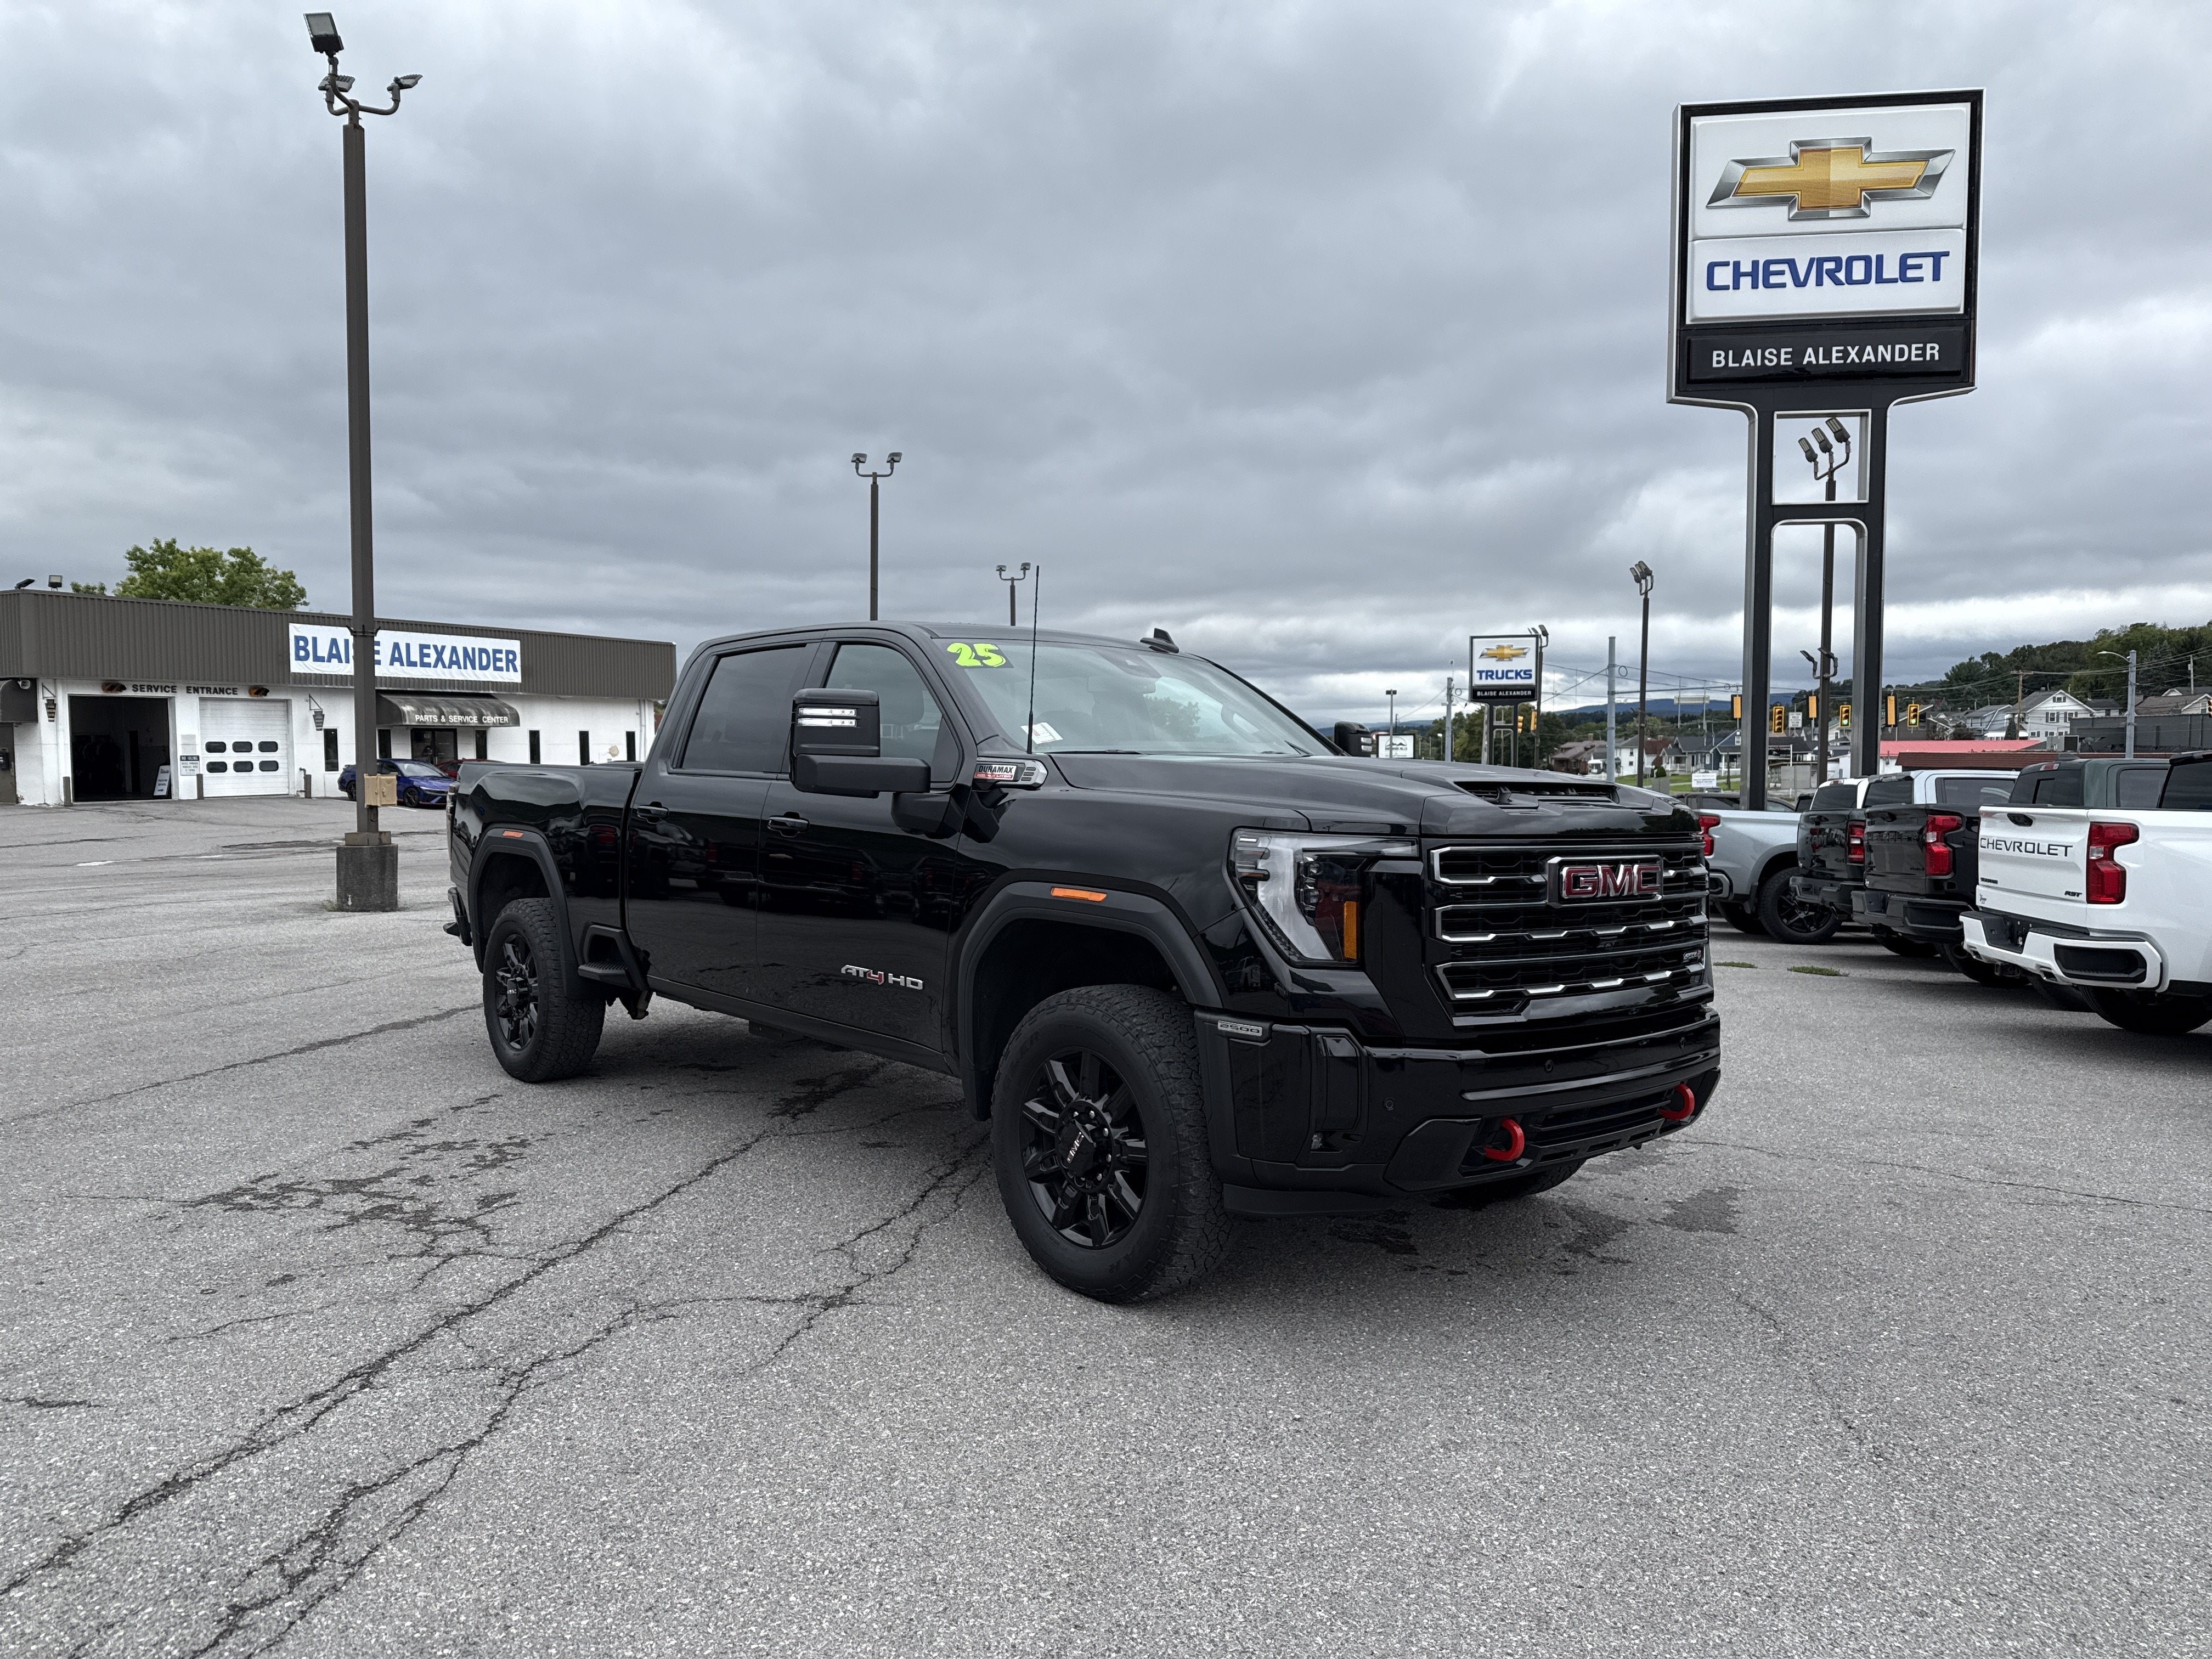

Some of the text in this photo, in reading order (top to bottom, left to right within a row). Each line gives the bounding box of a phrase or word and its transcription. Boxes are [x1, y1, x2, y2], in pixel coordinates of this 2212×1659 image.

[1706, 251, 1950, 291] CHEVROLET
[1712, 343, 1940, 368] BLAISE ALEXANDER
[294, 635, 518, 673] BLAIE ALEXANDER
[947, 642, 1006, 667] 25
[1476, 669, 1532, 680] TRUCKS
[132, 684, 238, 695] SERVICE ENTRANCE
[978, 765, 1014, 774] DURAMAX
[1980, 838, 2073, 857] CHEVROLET
[1562, 864, 1661, 899] GMC
[841, 964, 923, 990] AT4 HD
[1220, 1023, 1260, 1034] 2500
